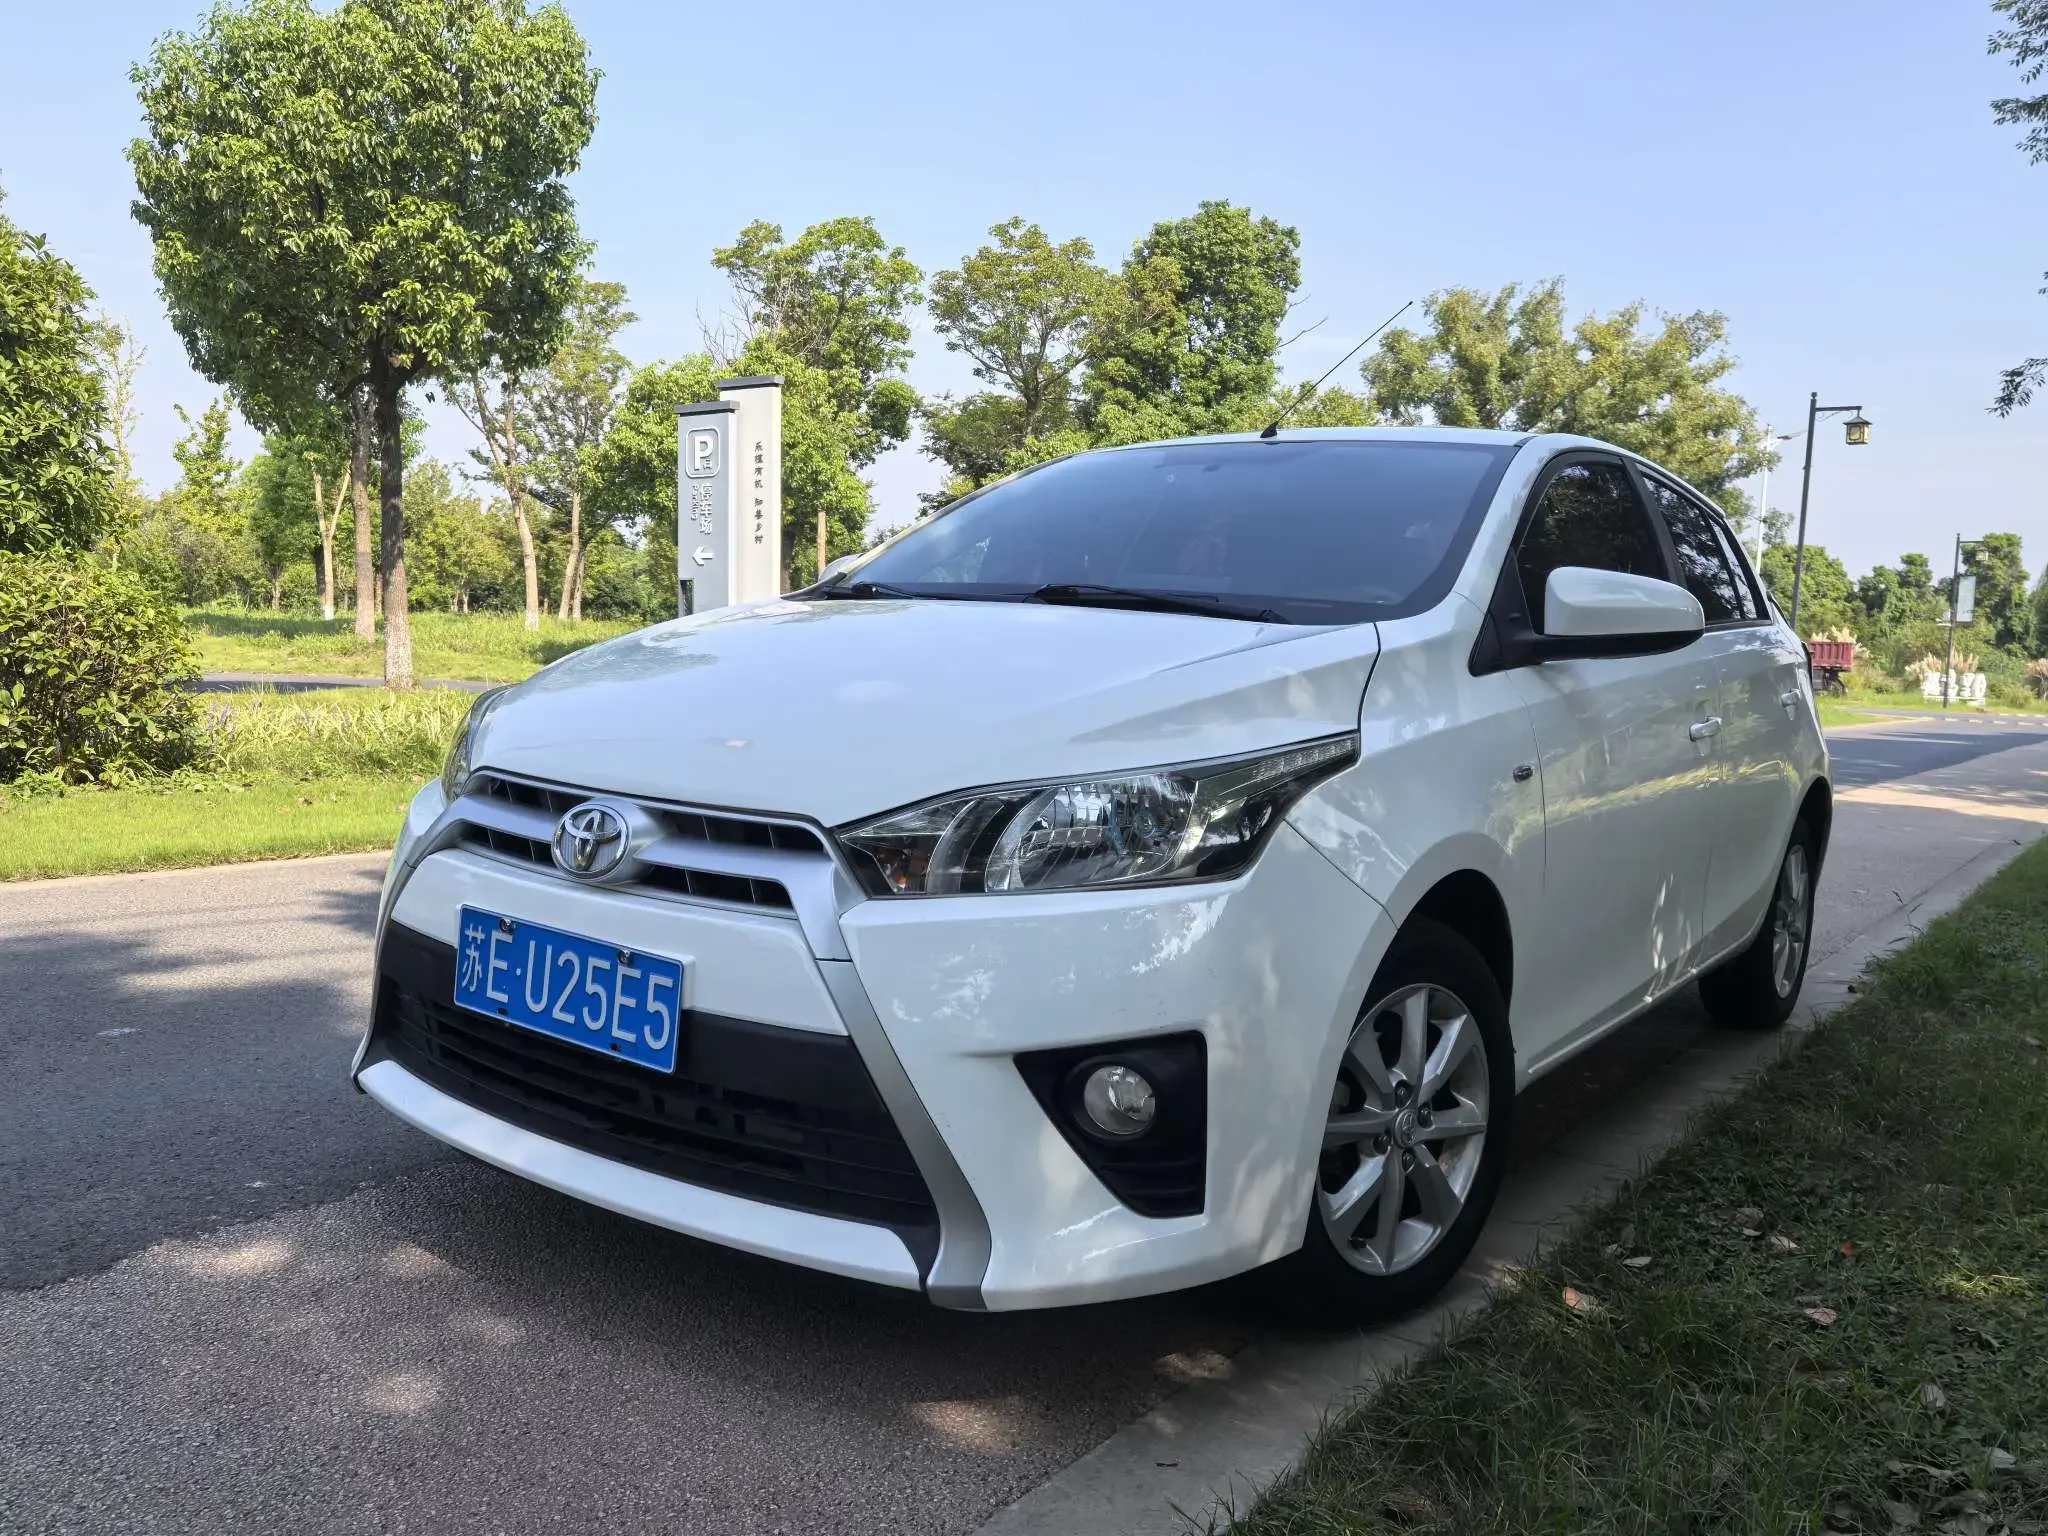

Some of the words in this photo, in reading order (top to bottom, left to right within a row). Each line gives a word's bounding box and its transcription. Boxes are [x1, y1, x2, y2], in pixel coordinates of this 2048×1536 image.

[693, 435, 714, 471] P
[700, 483, 713, 535] 停车场
[461, 923, 674, 1051] 苏E·U25E5
